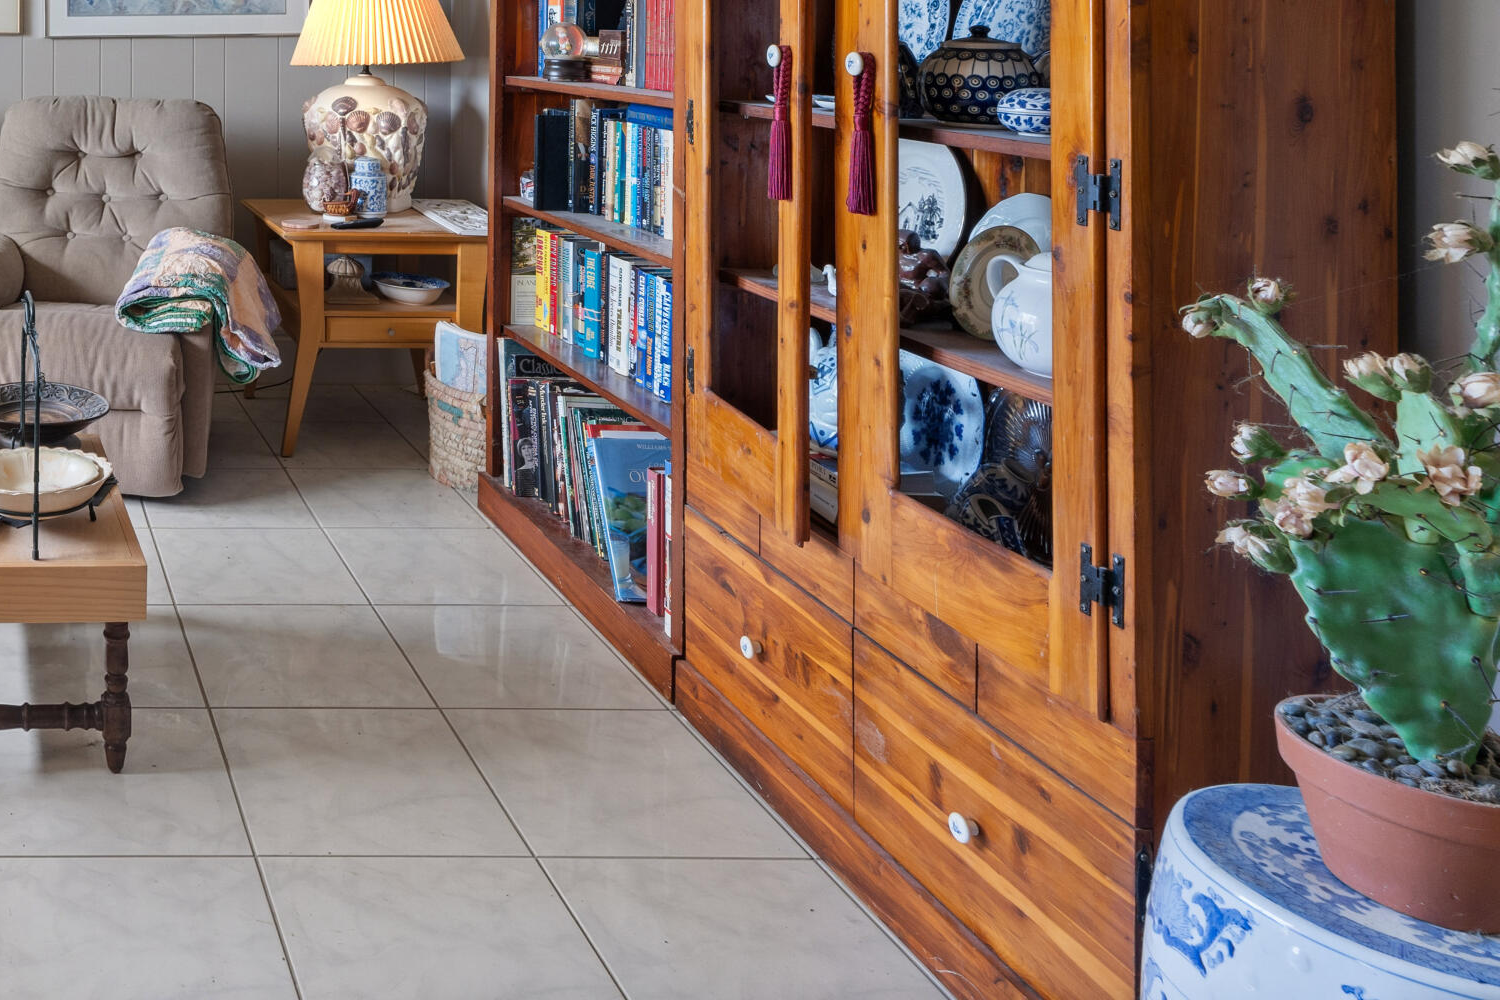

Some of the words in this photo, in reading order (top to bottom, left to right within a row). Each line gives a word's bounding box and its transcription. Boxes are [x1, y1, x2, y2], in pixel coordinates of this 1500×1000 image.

[590, 111, 598, 125] JACK
[536, 234, 544, 276] LONGSHOT
[586, 257, 596, 271] THE
[550, 256, 558, 287] FRANCIS
[586, 270, 595, 290] EDGE
[662, 292, 671, 318] CLIVE
[661, 317, 670, 358] CUSSLER
[662, 363, 671, 387] BLACK
